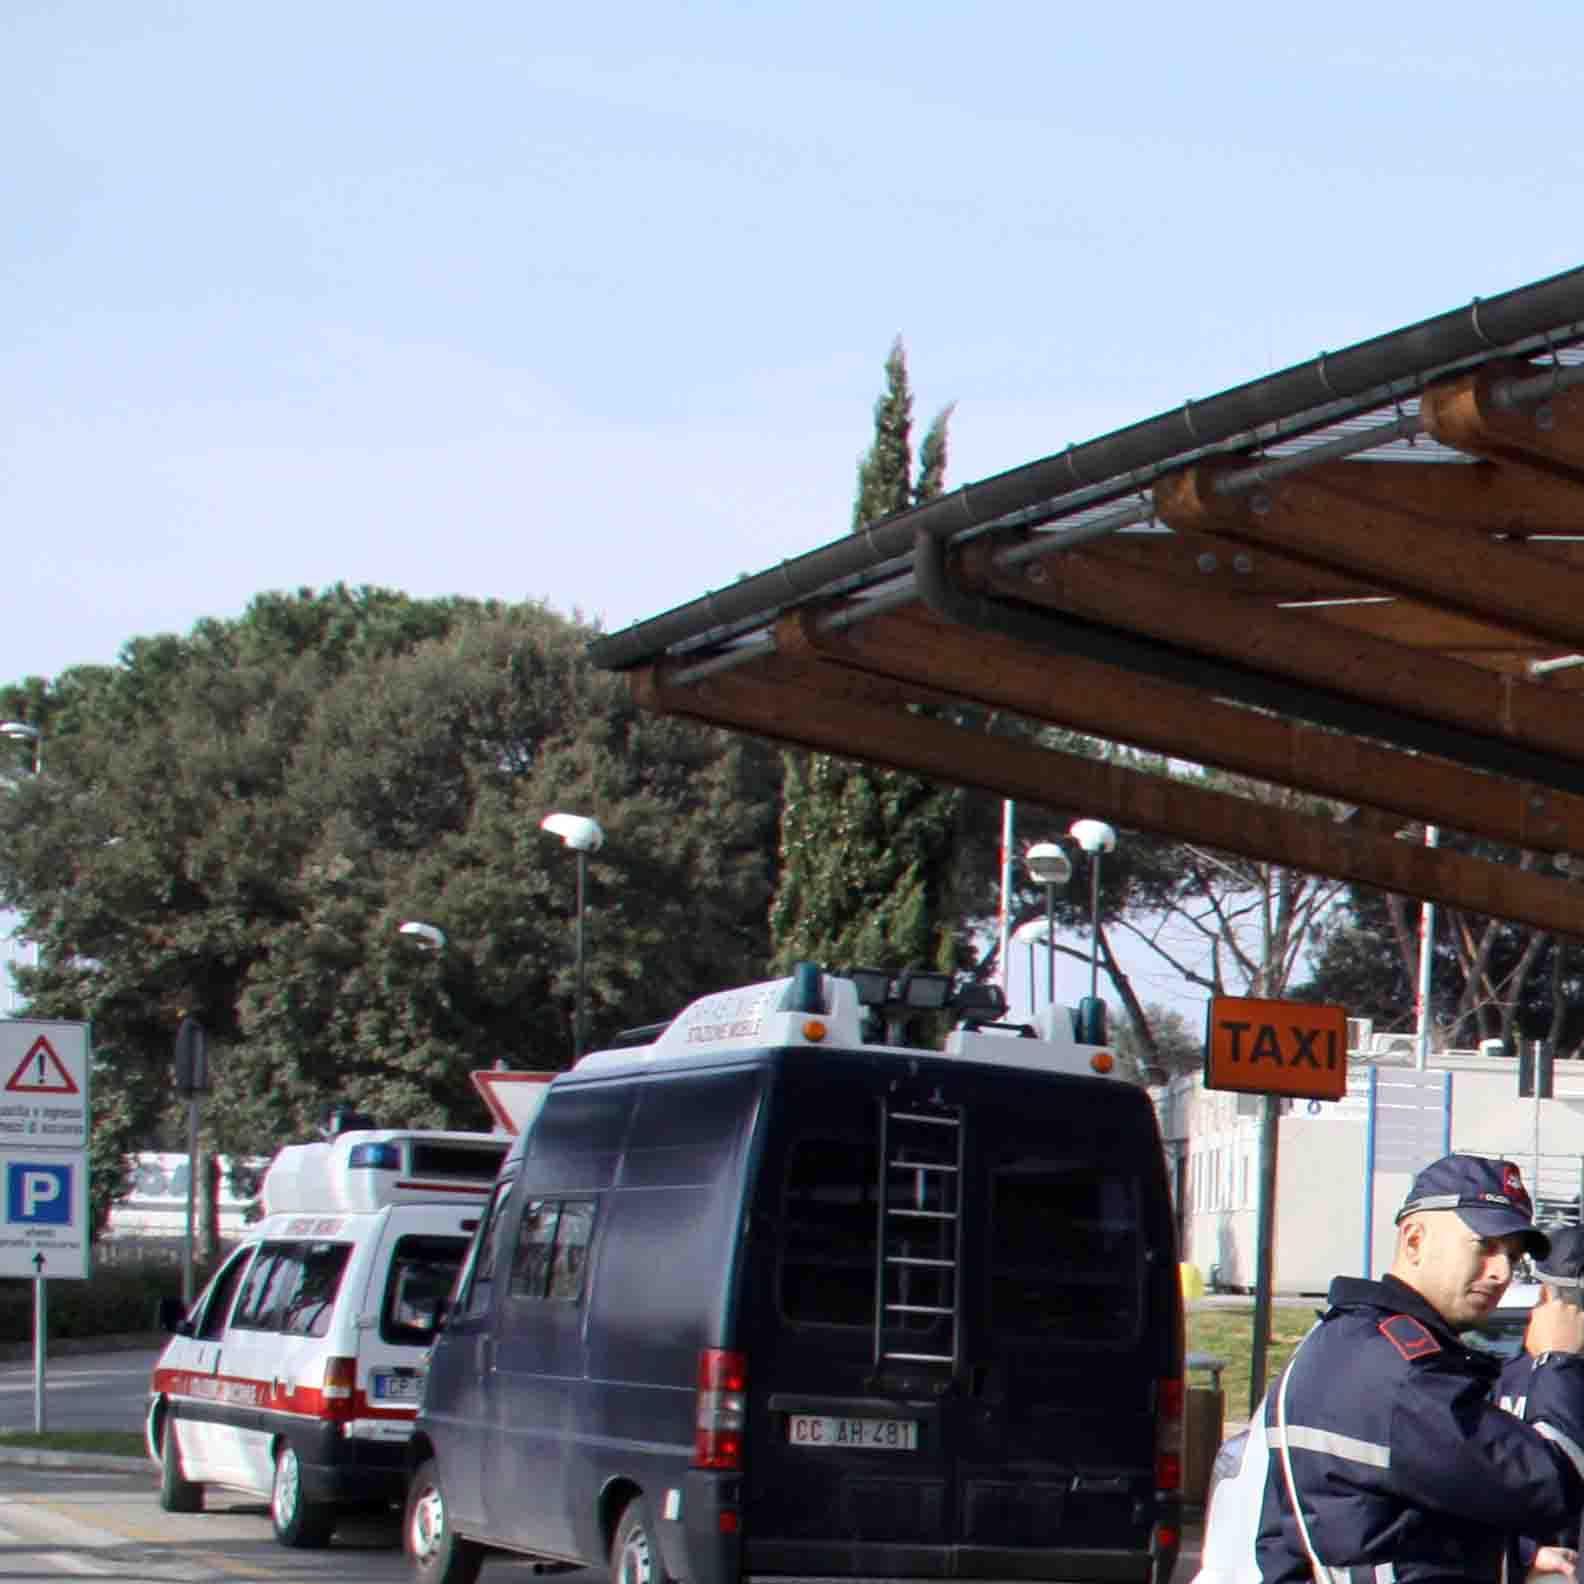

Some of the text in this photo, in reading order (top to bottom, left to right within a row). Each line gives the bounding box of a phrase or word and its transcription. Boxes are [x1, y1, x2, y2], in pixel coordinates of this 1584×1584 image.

[1219, 1021, 1338, 1070] TAXI
[23, 1171, 60, 1216] P
[796, 1419, 823, 1441] CC
[837, 1420, 864, 1443] AH
